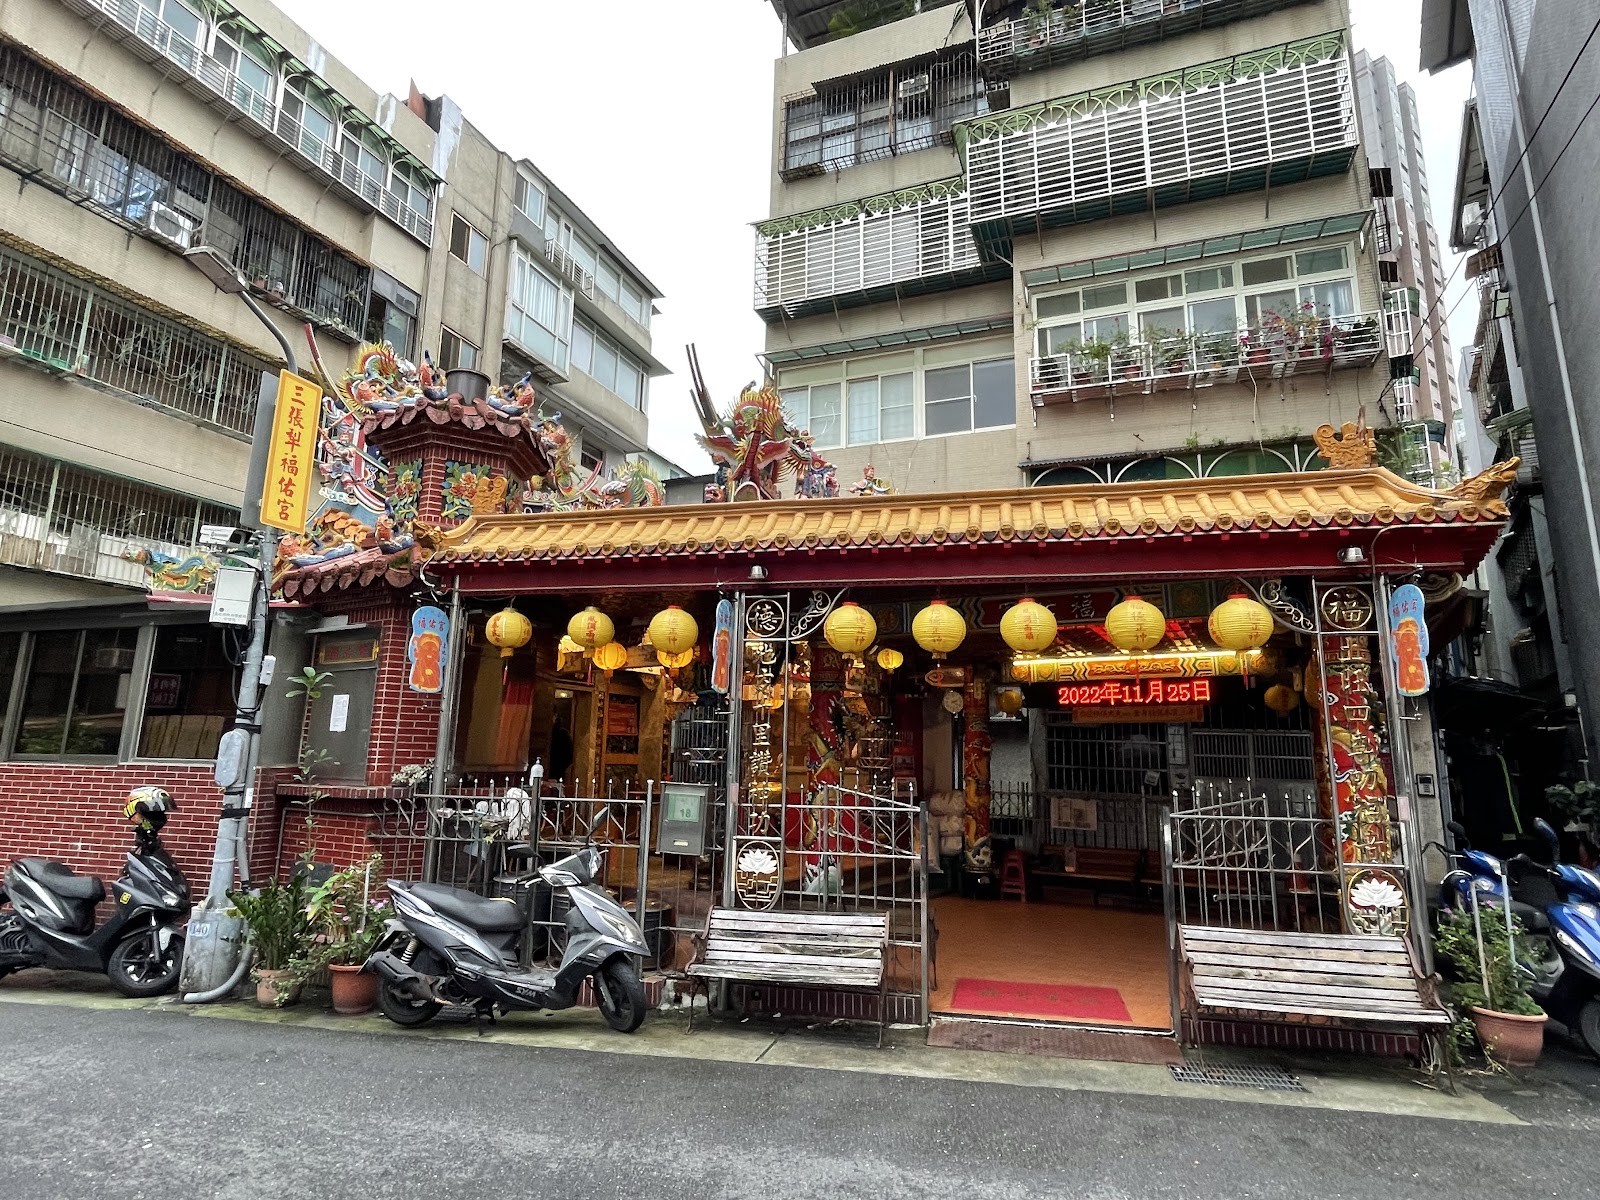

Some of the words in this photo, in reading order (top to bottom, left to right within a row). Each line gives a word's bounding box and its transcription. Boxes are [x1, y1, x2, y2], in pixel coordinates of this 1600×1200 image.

[276, 385, 306, 522] 三張犁福佑宮
[753, 603, 778, 632] 德
[1329, 592, 1364, 623] 福
[418, 617, 446, 632] 福佑宮
[1058, 680, 1211, 706] 2022年11月25日
[515, 986, 536, 998] SYM
